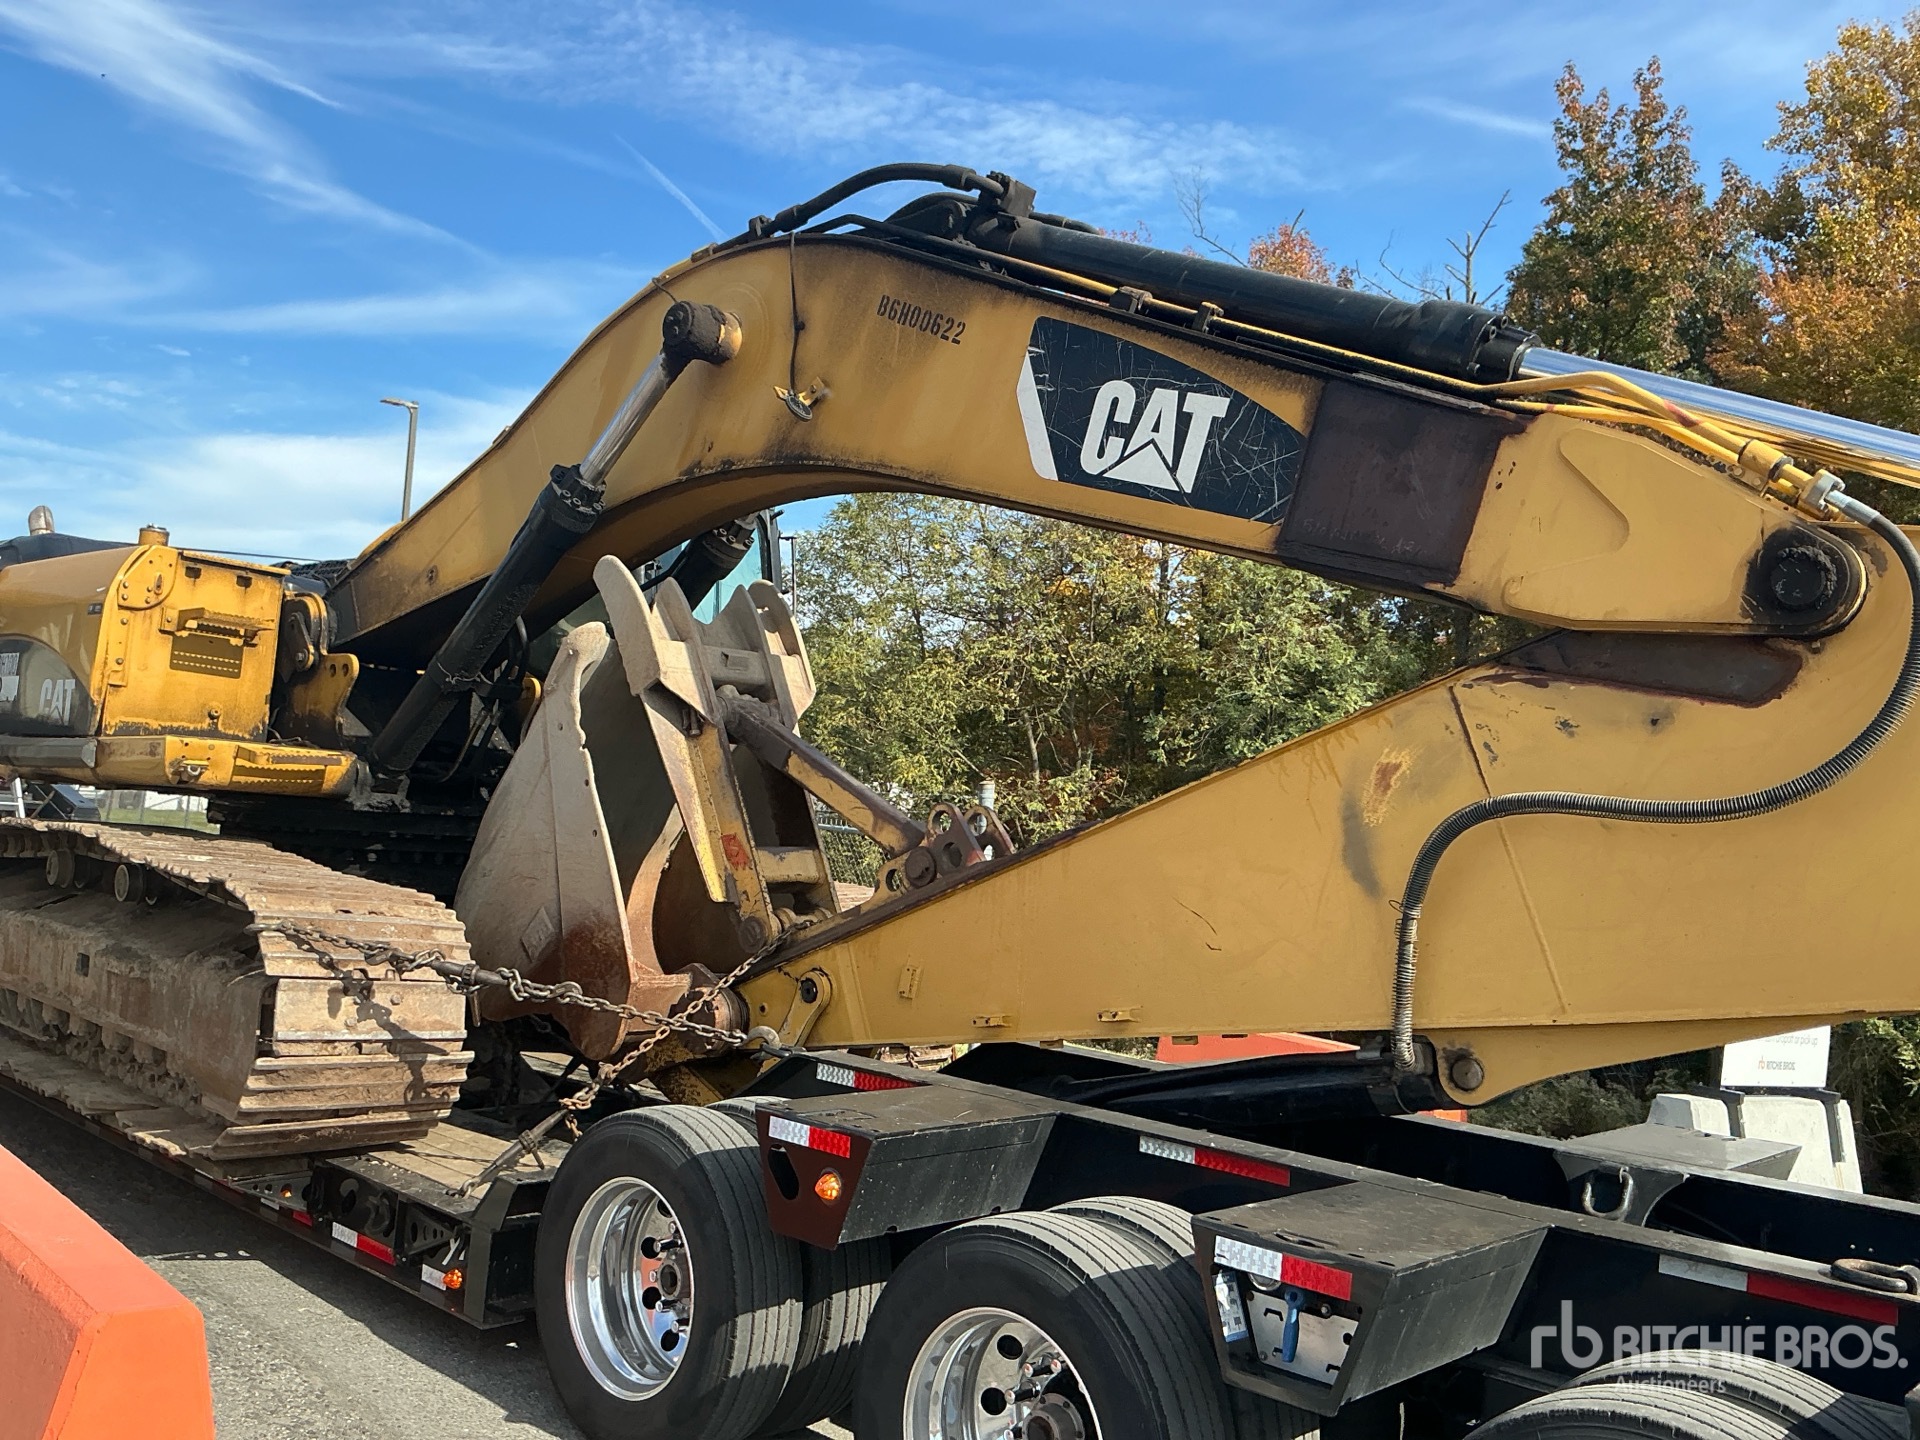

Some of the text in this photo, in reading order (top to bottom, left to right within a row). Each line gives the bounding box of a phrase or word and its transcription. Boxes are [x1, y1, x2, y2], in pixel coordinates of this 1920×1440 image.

[877, 295, 966, 345] B6H00622
[1080, 380, 1231, 494] CAT
[39, 678, 76, 726] CAT
